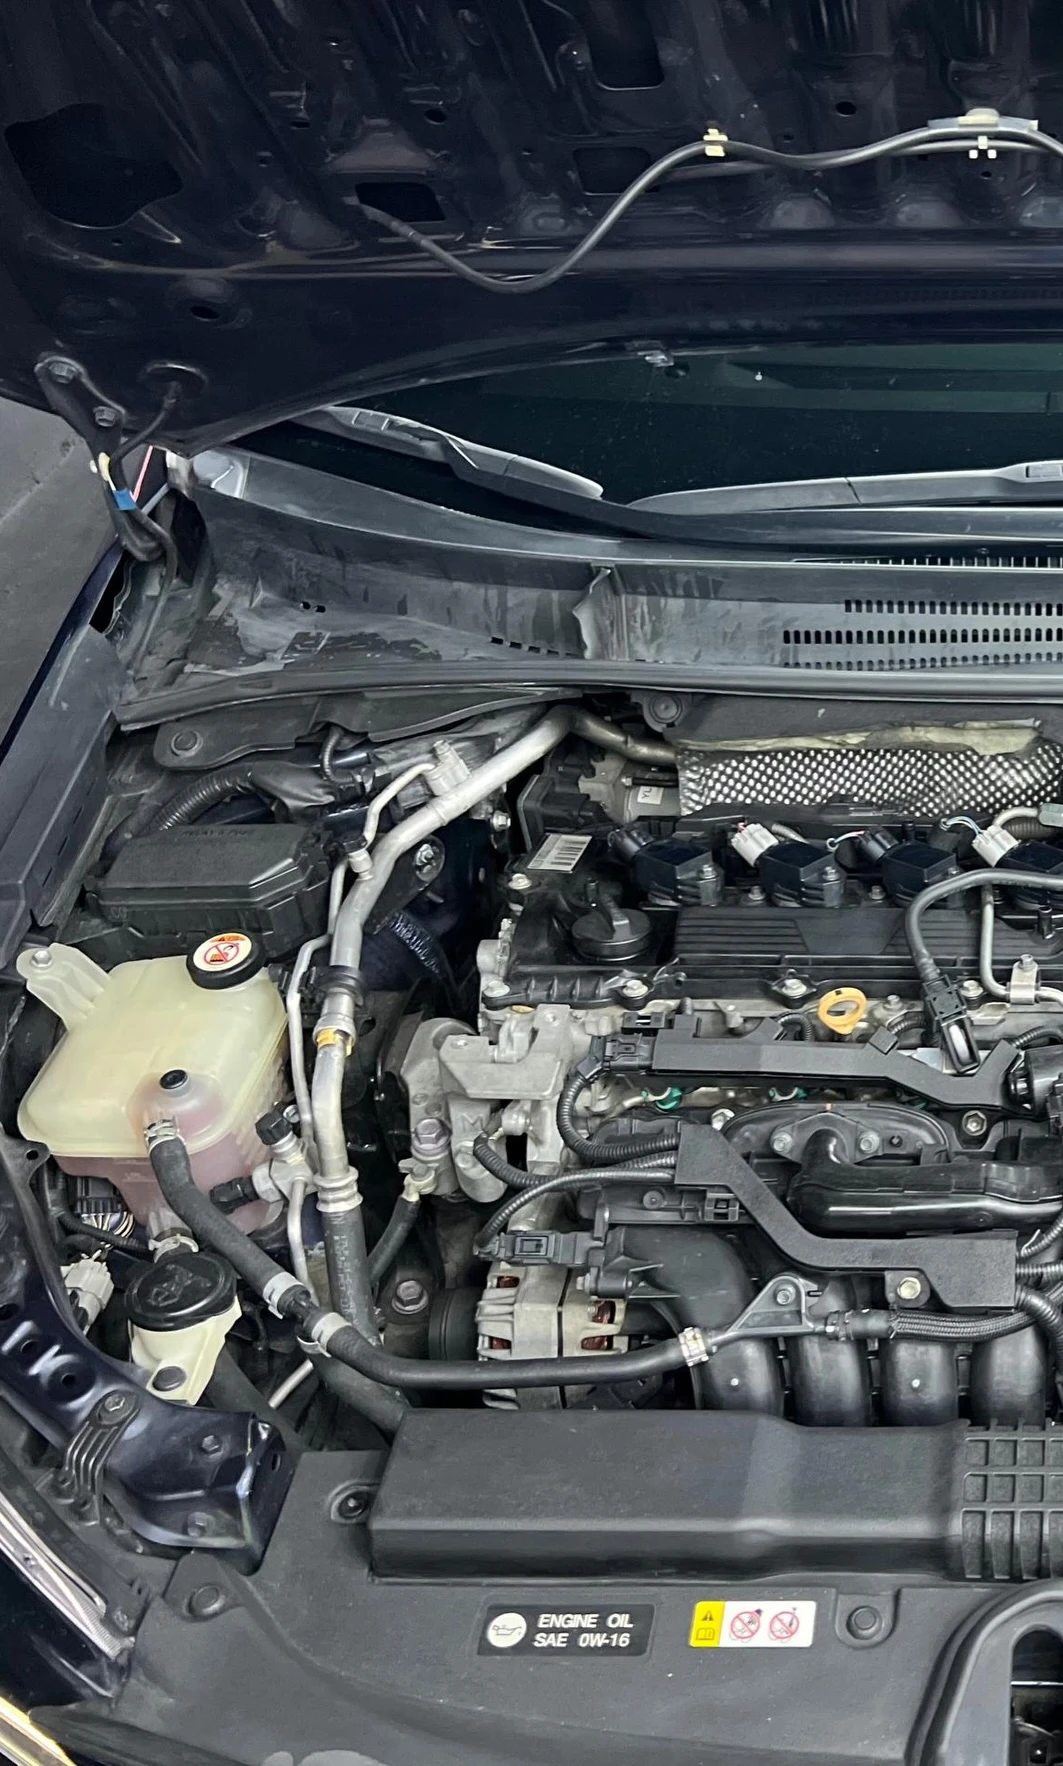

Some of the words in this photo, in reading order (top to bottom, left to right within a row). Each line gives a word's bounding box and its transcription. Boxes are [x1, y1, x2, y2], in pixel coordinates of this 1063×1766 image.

[537, 1613, 599, 1628] ENGINE
[606, 1613, 634, 1628] OIL
[533, 1632, 568, 1647] SAE
[578, 1632, 631, 1647] 0W-16
